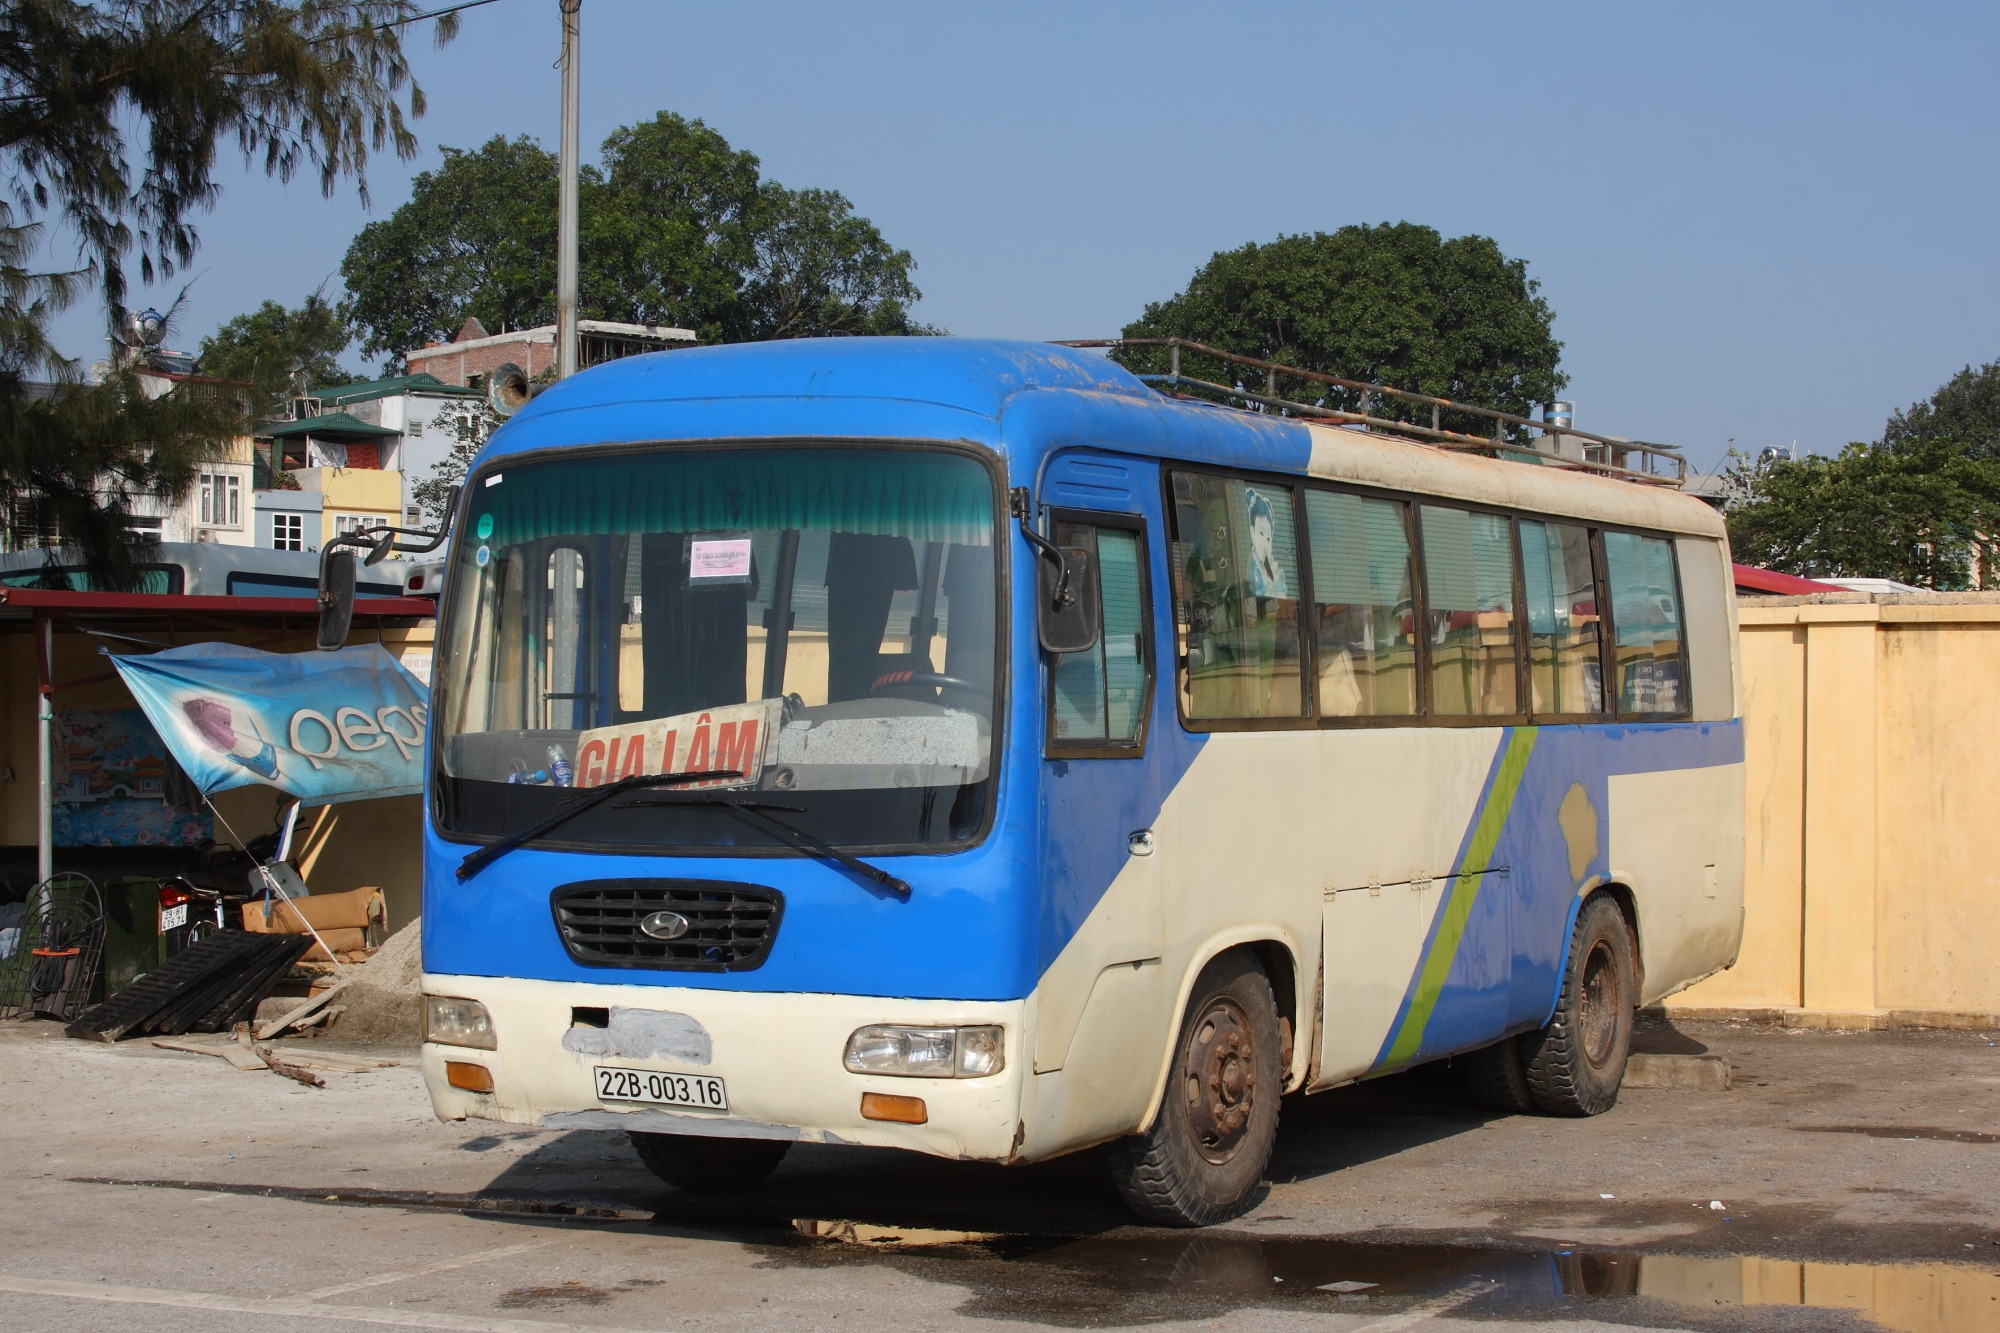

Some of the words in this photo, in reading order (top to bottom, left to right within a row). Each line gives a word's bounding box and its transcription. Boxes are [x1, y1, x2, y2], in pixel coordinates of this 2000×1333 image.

[577, 734, 645, 788] GIA
[658, 713, 759, 790] LÂM
[600, 1071, 722, 1105] 22B-003.16
